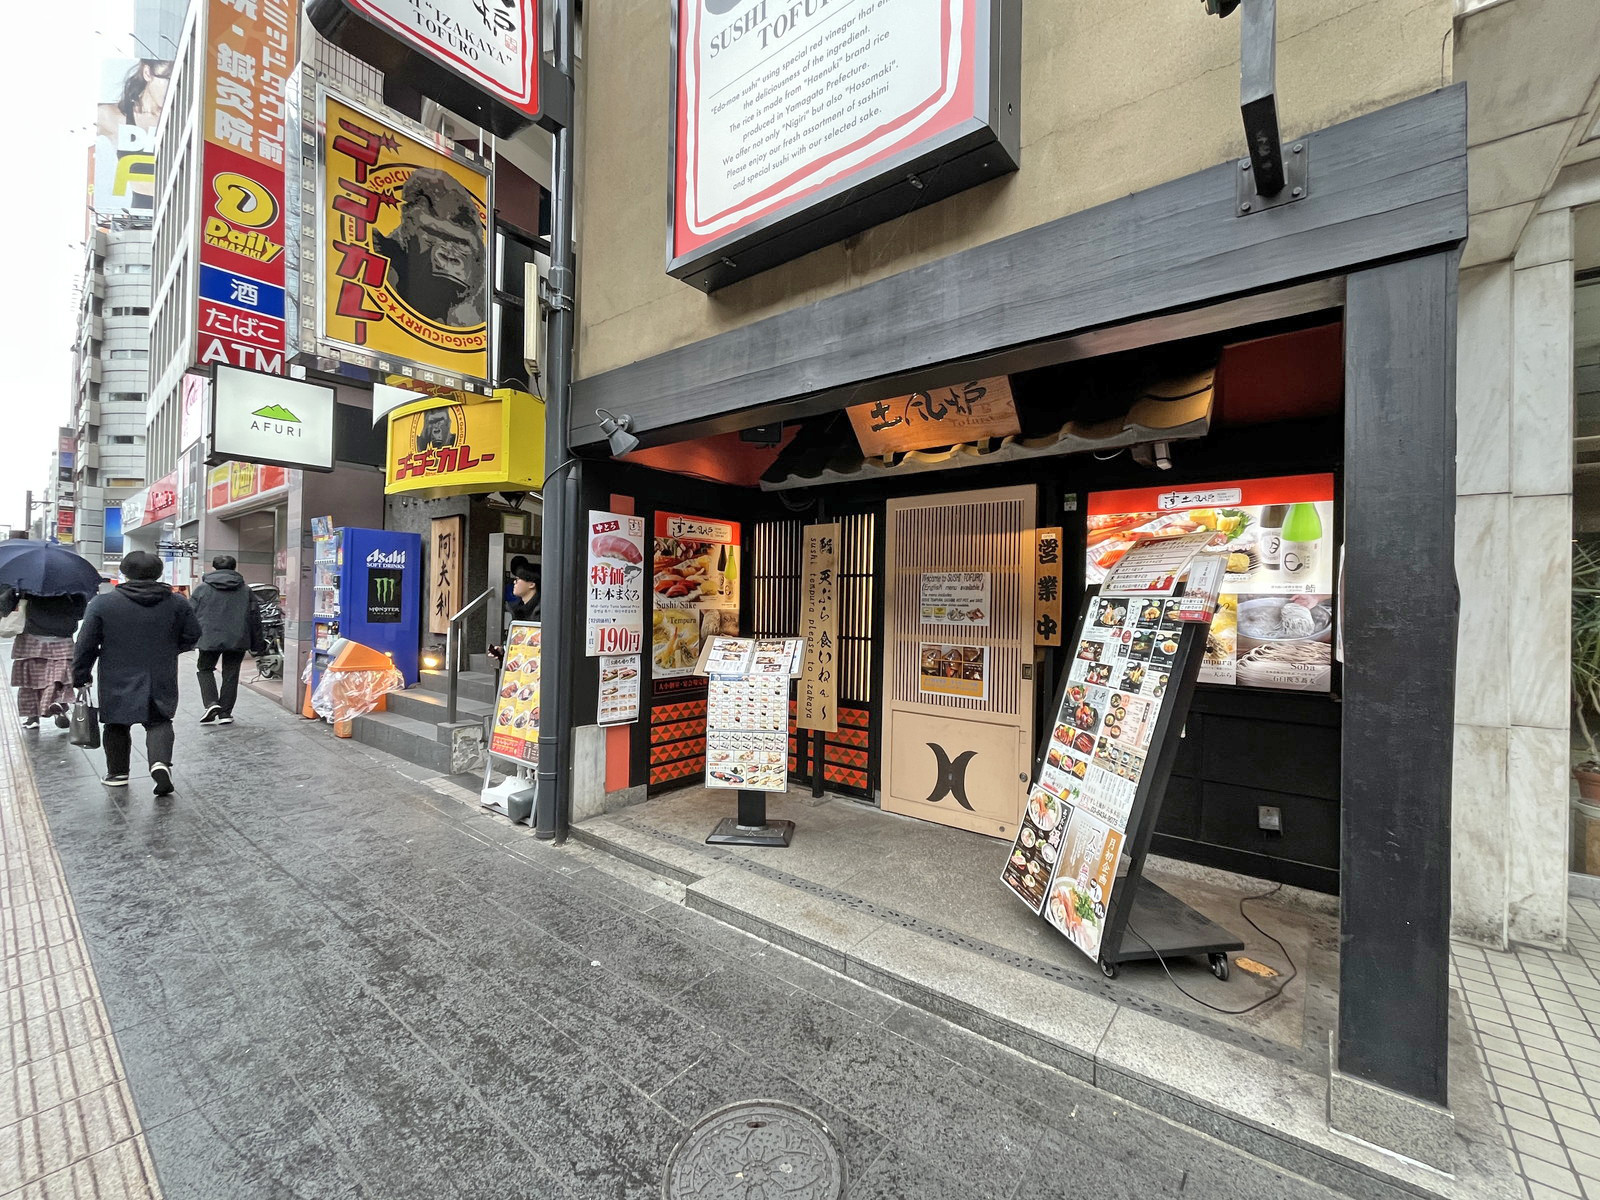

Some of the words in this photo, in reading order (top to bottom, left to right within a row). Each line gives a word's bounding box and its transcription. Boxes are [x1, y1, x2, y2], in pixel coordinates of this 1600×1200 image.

[413, 10, 479, 60] TOFURO
[710, 0, 768, 59] SUSHI
[762, 67, 780, 83] using
[782, 45, 808, 71] special
[809, 35, 823, 52] red
[825, 17, 856, 42] vinegar
[858, 4, 875, 20] that
[729, 122, 741, 133] The
[742, 114, 754, 126] rice
[756, 109, 762, 117] is
[763, 96, 783, 113] made
[784, 85, 802, 100] from
[845, 38, 871, 63] brand
[873, 31, 890, 46] rice
[743, 99, 754, 110] the
[755, 70, 800, 103] deliciousness
[802, 60, 811, 72] of
[812, 54, 824, 66] the
[826, 25, 870, 58] ingredient.
[742, 114, 775, 142] produced
[776, 111, 784, 122] in
[785, 87, 824, 115] Yamagata
[826, 62, 870, 91] Prefecture.
[722, 155, 734, 166] We
[735, 145, 751, 160] offer
[752, 137, 763, 150] not
[764, 129, 780, 143] only
[811, 103, 824, 116] but
[826, 93, 843, 107] also
[726, 164, 747, 179] Please
[748, 152, 768, 165] enjoy
[769, 144, 782, 156] our
[783, 131, 801, 148] fresh
[803, 108, 844, 137] assortment
[846, 100, 856, 112] of
[858, 81, 889, 107] sashimi
[732, 176, 746, 191] and
[747, 163, 771, 184] special
[772, 153, 790, 170] sushi
[791, 144, 807, 159] with
[808, 138, 822, 150] our
[824, 116, 857, 142] selected
[859, 106, 882, 123] sake.
[205, 216, 284, 263] Daily
[206, 234, 262, 260] YAMAZAKI
[331, 117, 402, 345] ゴーゴーカレー
[230, 278, 258, 306] 酒
[205, 307, 280, 343] たばこ
[201, 338, 282, 375] ATM
[251, 420, 301, 437] AFURI
[396, 445, 495, 480] ゴーゴーカレー
[366, 549, 405, 564] Asahi
[590, 565, 625, 586] 特価
[436, 533, 452, 620] 阿夫利
[591, 588, 640, 601] 生本まぐろ
[808, 574, 816, 613] tempura
[1036, 538, 1059, 641] 営業中
[598, 627, 640, 653] 190円
[670, 616, 697, 626] Tempura
[807, 619, 816, 654] please
[807, 661, 814, 672] to
[1291, 663, 1316, 671] Soba
[805, 679, 813, 719] izakaya
[1098, 837, 1117, 886] 月初企画
